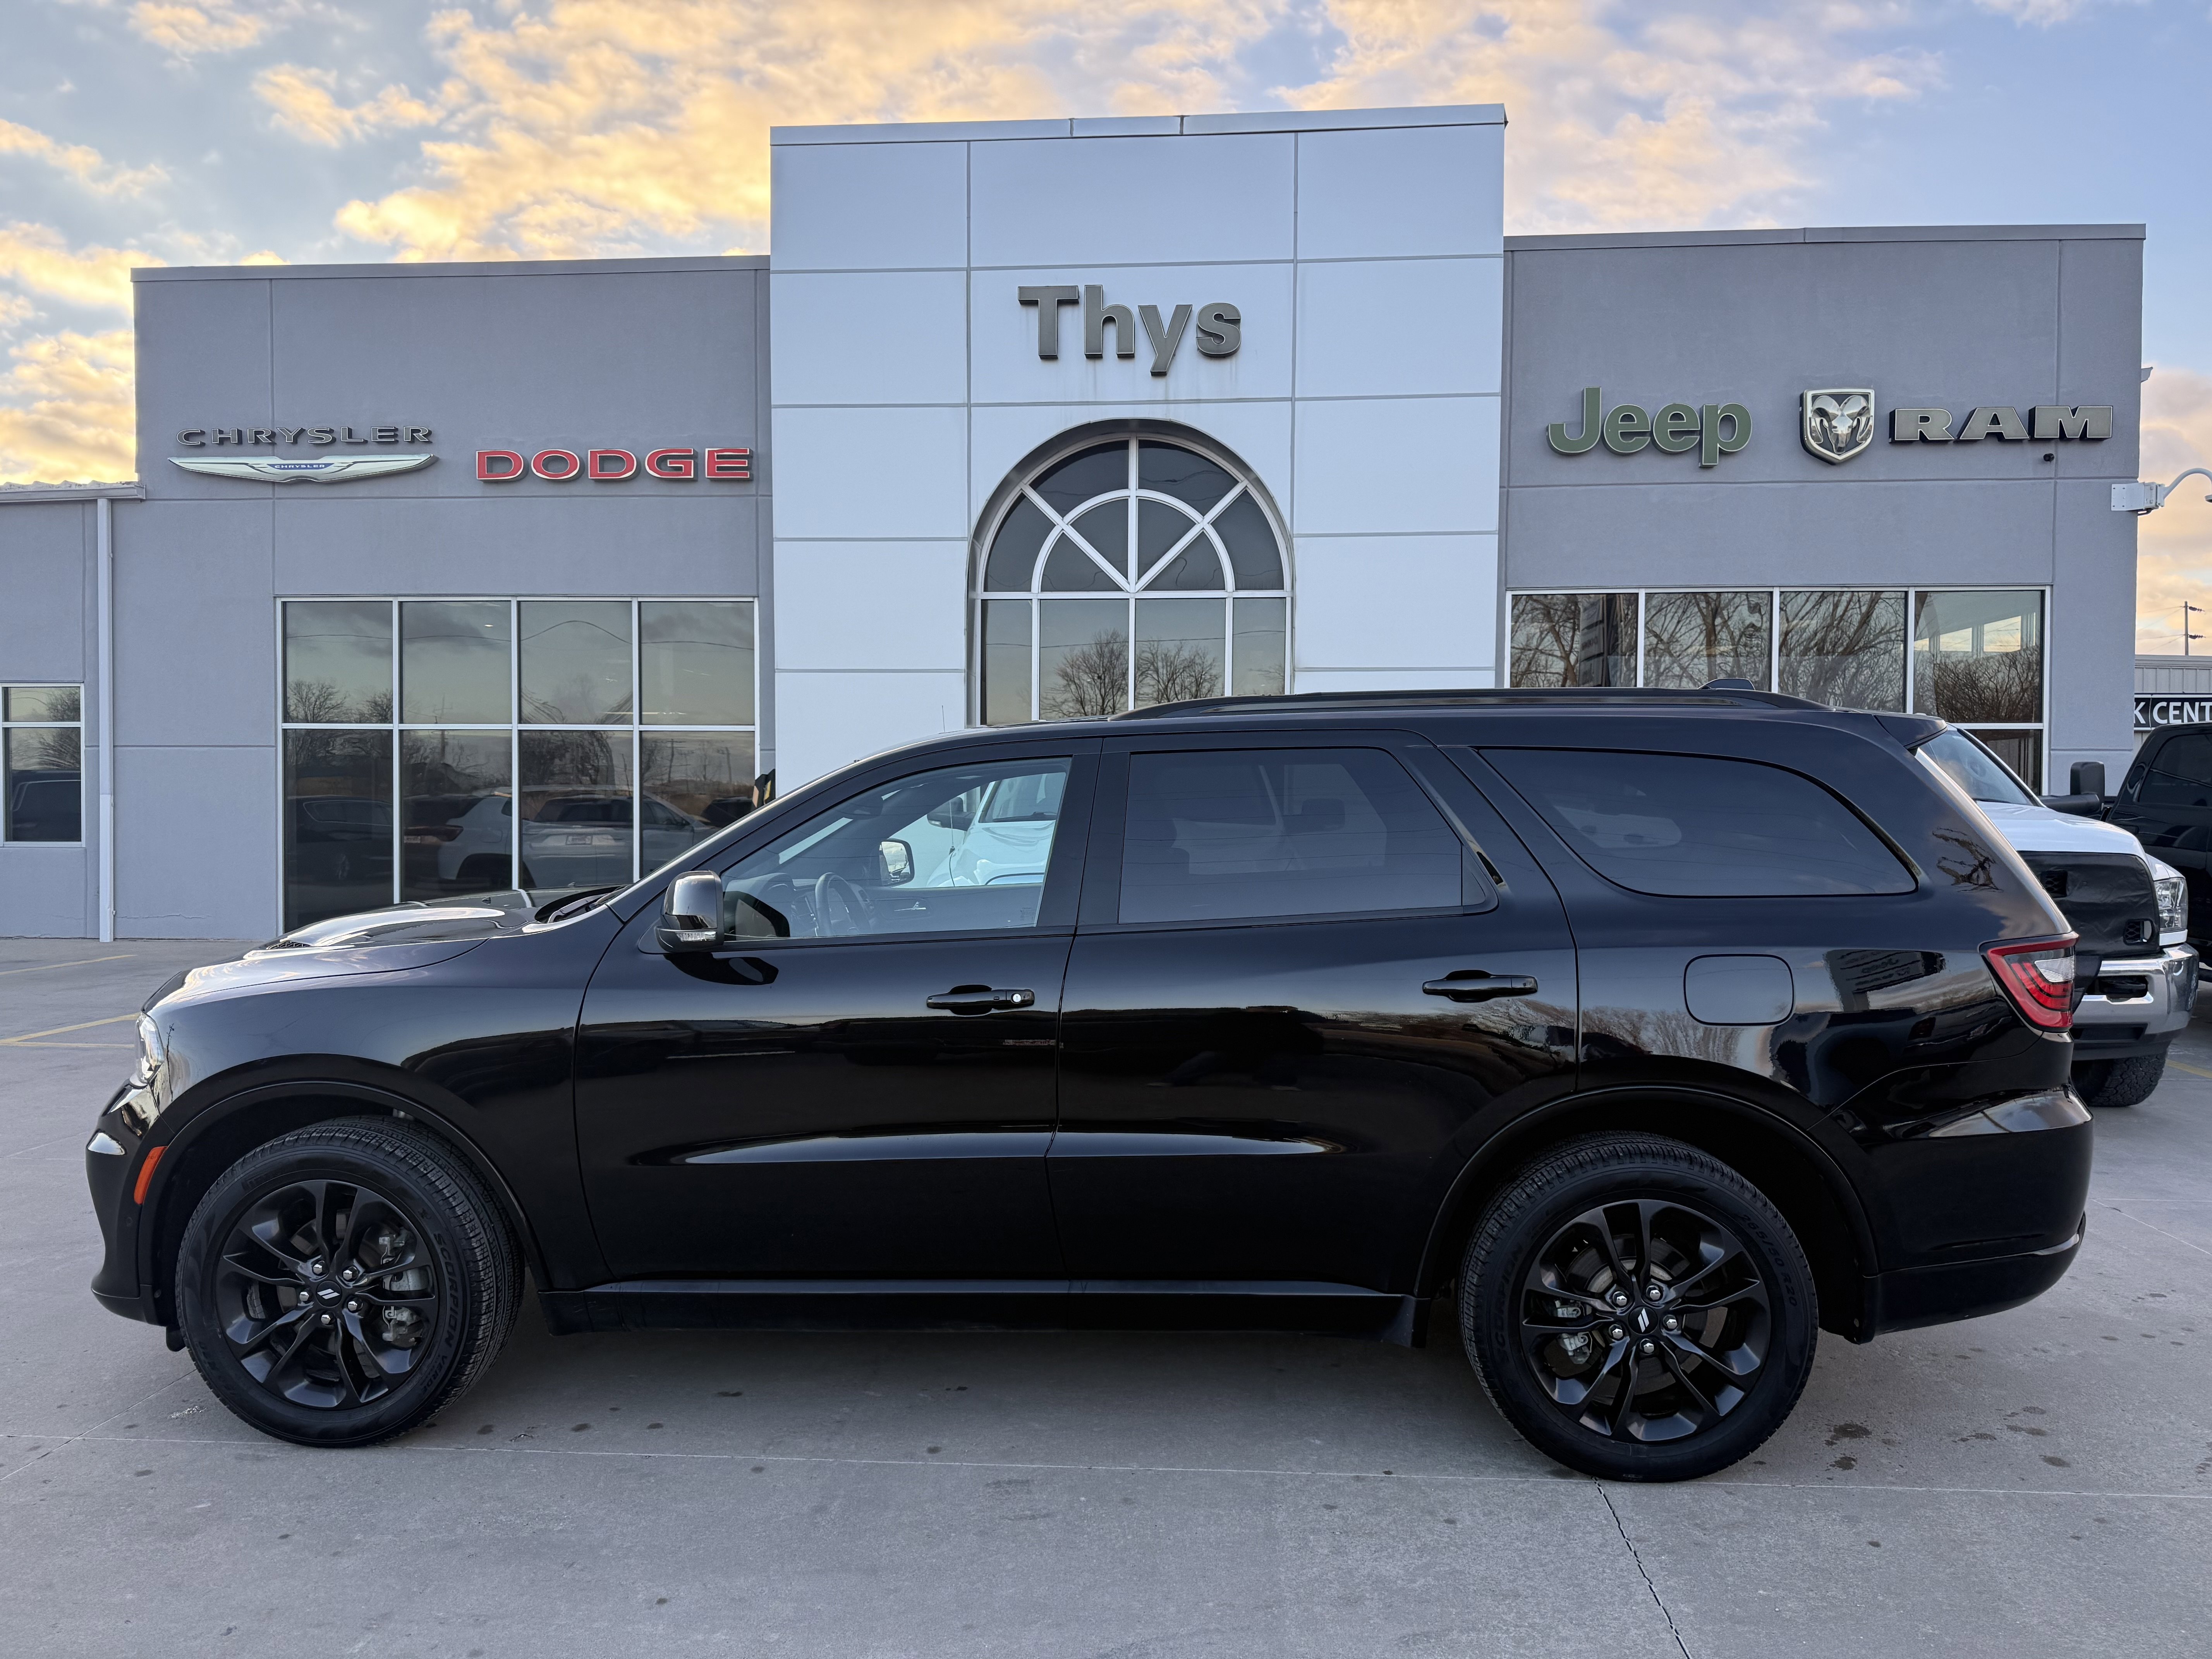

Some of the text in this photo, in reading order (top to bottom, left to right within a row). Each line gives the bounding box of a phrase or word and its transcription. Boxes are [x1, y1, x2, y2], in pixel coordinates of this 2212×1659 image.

[1018, 285, 1242, 376] Thys
[176, 426, 433, 446] CHRYSLER
[1546, 386, 1752, 467] Jeep
[1889, 405, 2114, 443] RAM
[476, 448, 754, 481] DODGE
[2153, 702, 2212, 724] CENT
[433, 1232, 459, 1348] SCORPION
